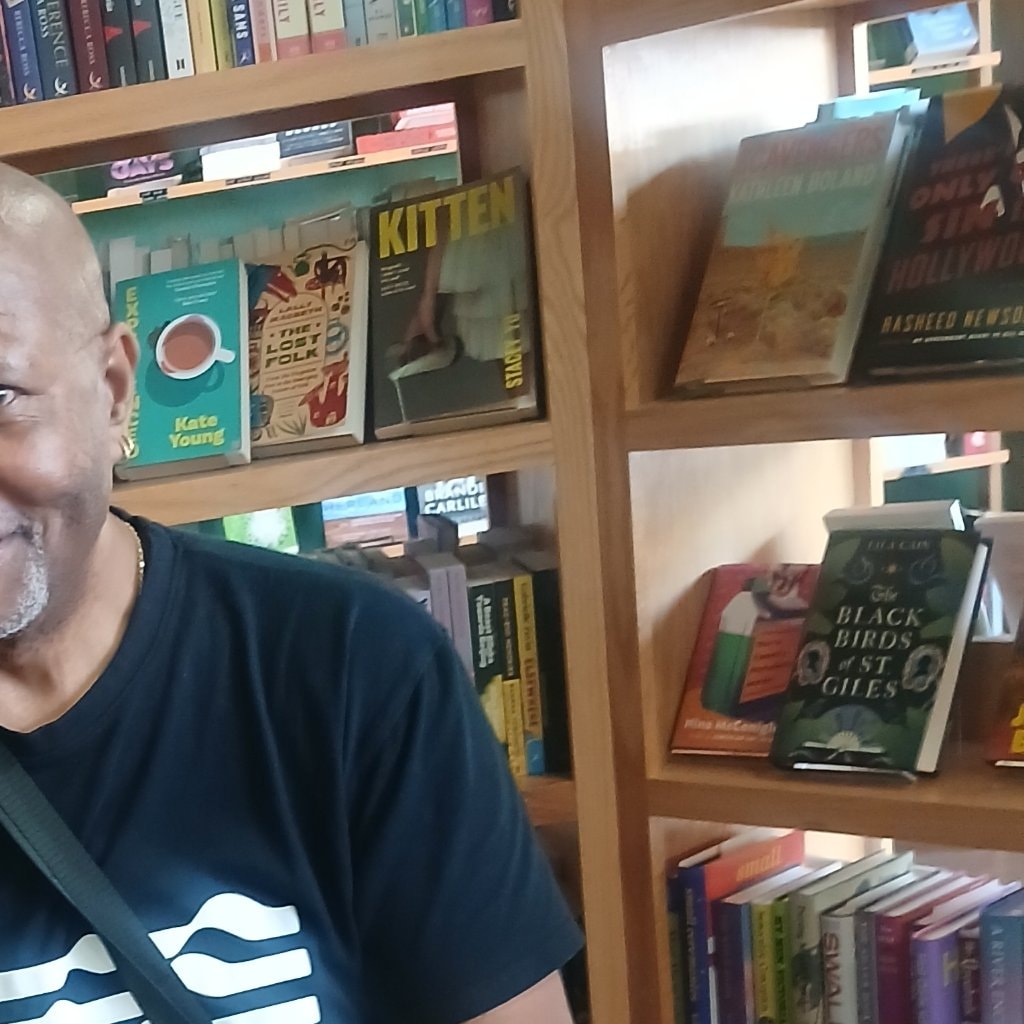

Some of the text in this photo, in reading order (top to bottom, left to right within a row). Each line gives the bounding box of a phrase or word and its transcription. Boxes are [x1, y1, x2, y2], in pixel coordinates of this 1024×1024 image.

[37, 9, 49, 39] ROSS
[379, 176, 515, 259] KITTEN
[881, 304, 1024, 333] RASHEED NEWSO
[279, 323, 311, 338] THE
[266, 333, 321, 355] LOST
[265, 347, 318, 369] FOLK
[175, 415, 218, 432] Kate
[169, 429, 225, 448] Young
[425, 480, 484, 503] BRANDI
[836, 604, 926, 629] BLACK
[834, 629, 914, 650] BIRDS
[838, 655, 853, 672] of
[822, 675, 902, 699] GILES
